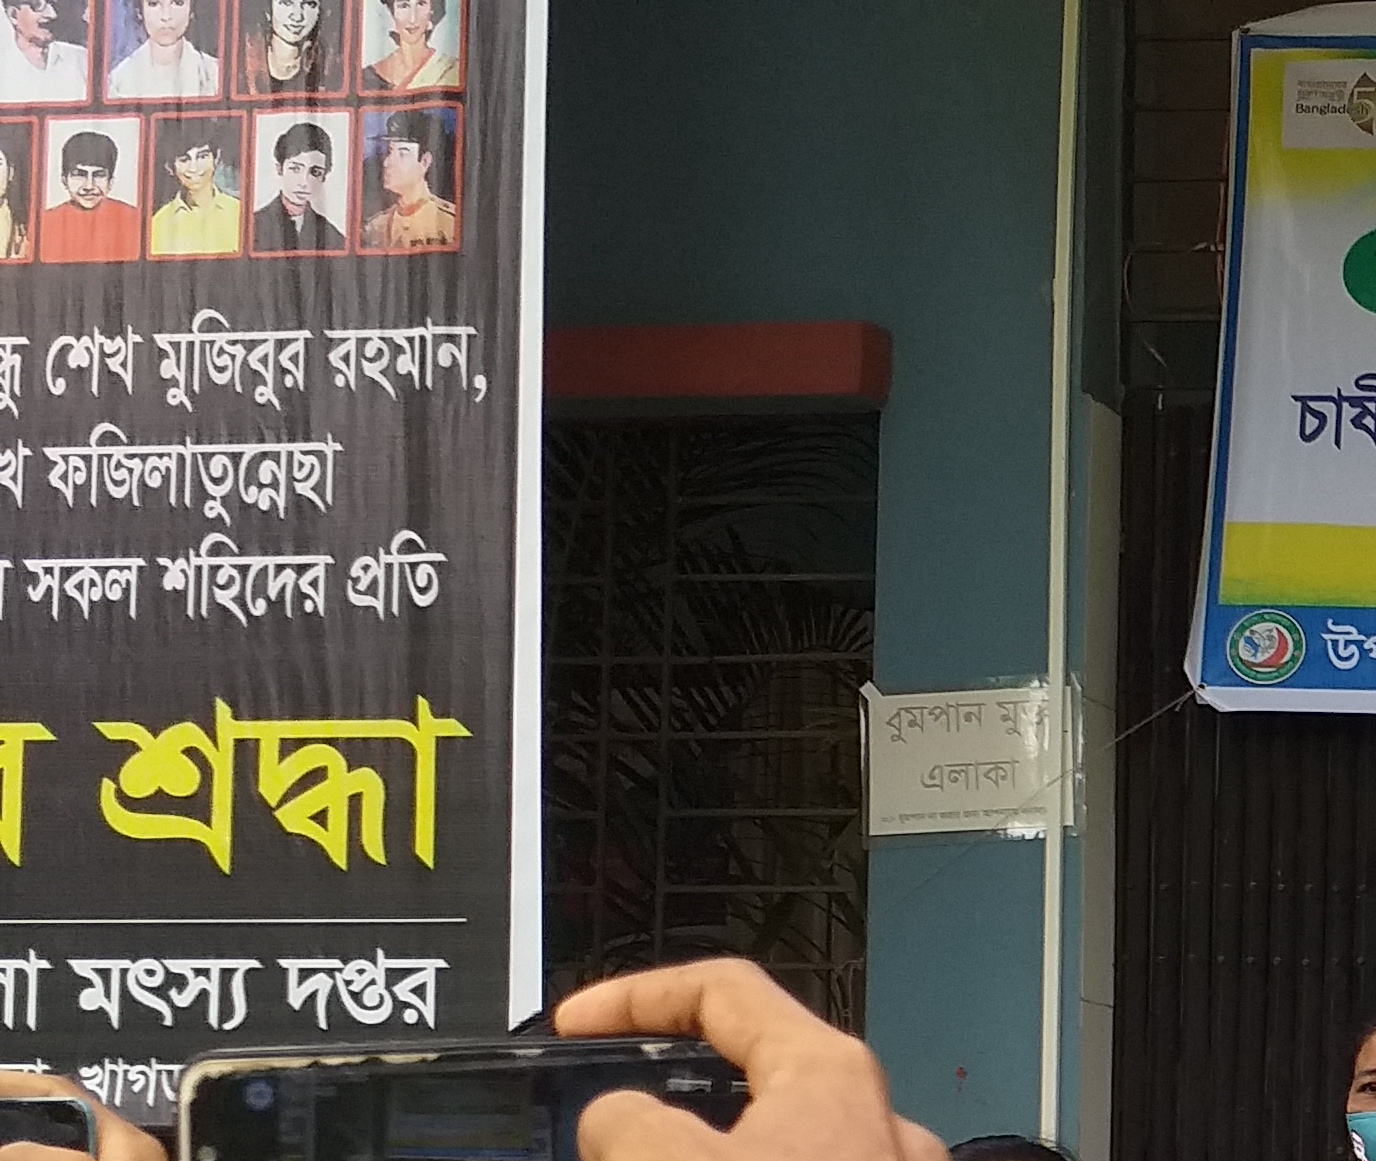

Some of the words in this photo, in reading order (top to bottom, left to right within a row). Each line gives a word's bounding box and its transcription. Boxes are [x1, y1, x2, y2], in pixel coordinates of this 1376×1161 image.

[46, 324, 144, 397] শেখ
[152, 309, 313, 412] মুজিবুর
[325, 318, 488, 402] রহমান,
[23, 557, 146, 621] সকল
[156, 533, 335, 627] শহিদের
[347, 530, 449, 621] প্রতি
[93, 695, 473, 875] শ্রদ্ধা
[921, 759, 1019, 792] এলাকা
[66, 957, 263, 1031] মৎস্য
[279, 948, 450, 1030] দপ্তর
